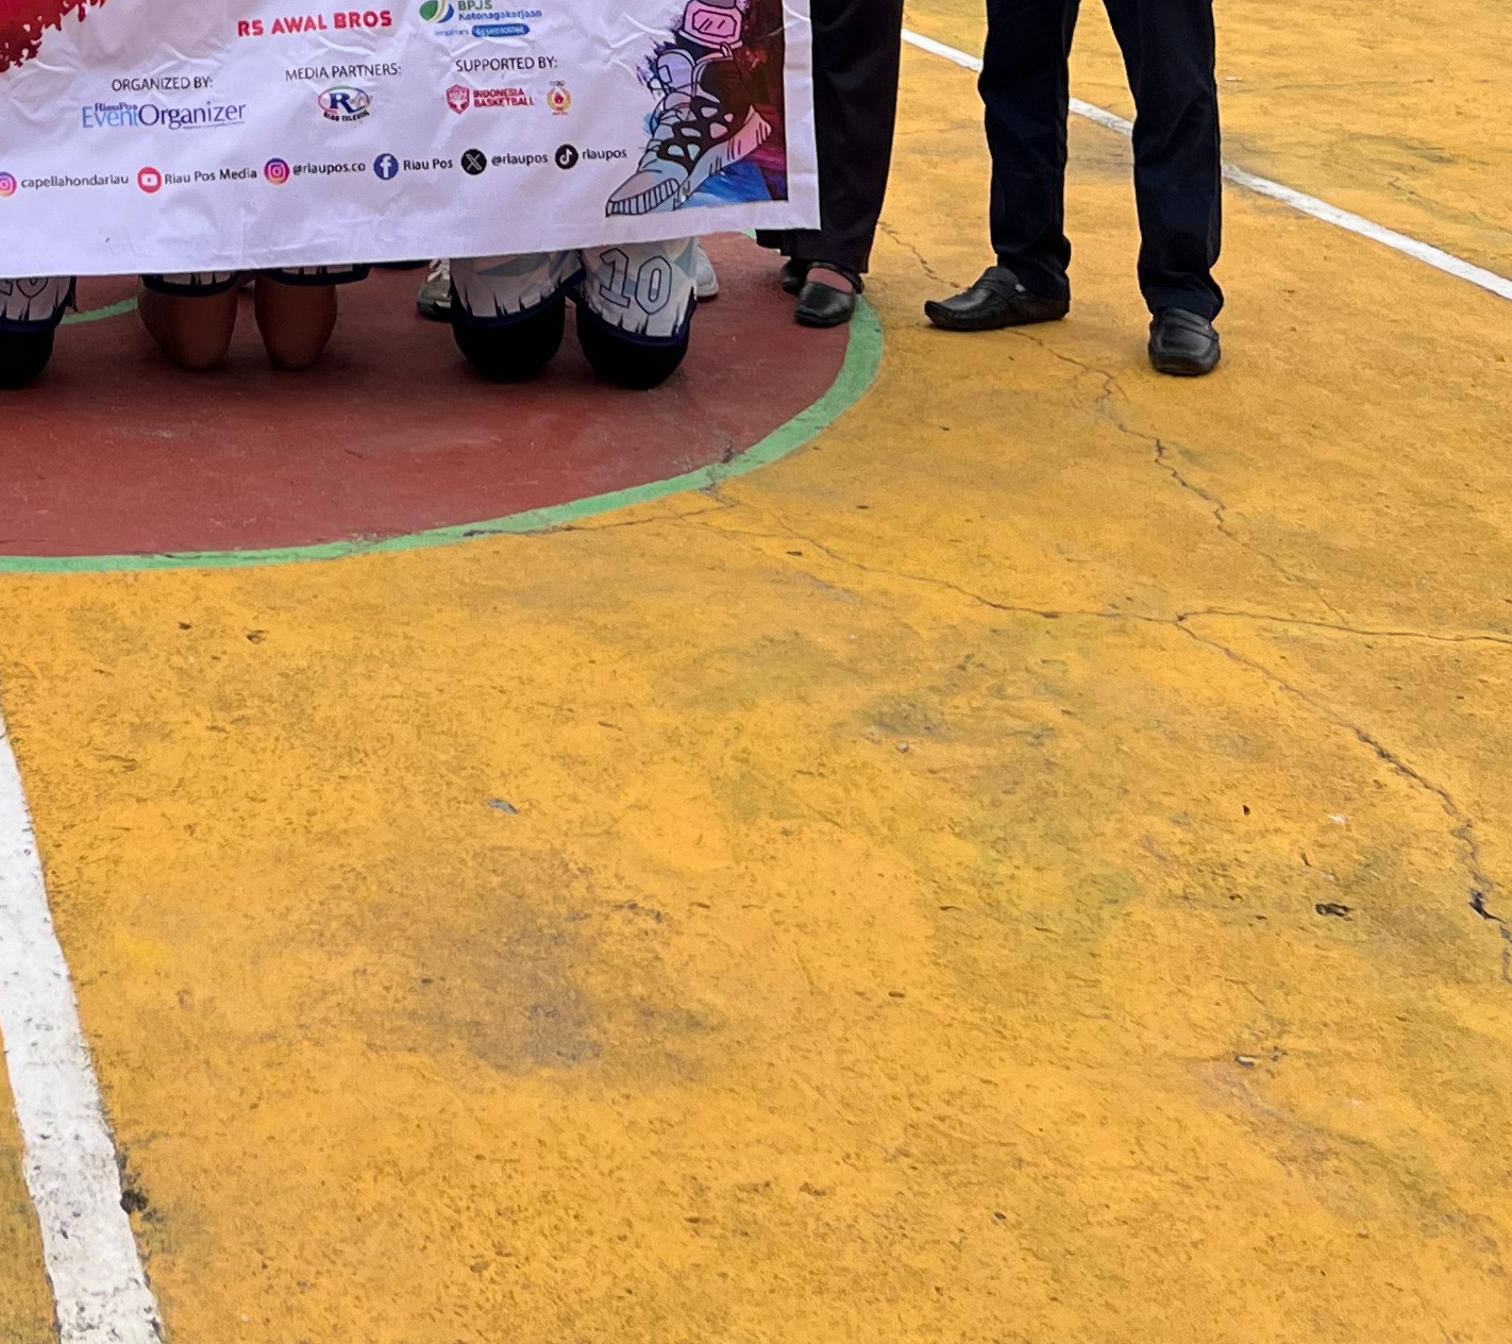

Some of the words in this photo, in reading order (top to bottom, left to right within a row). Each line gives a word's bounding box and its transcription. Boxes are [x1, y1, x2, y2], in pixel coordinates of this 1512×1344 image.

[457, 0, 494, 11] BPJS
[238, 19, 264, 37] RS
[271, 14, 327, 34] AWAL
[334, 10, 393, 29] BROS
[285, 66, 330, 81] MEDIA
[332, 62, 402, 78] PARTNERS:
[455, 56, 536, 72] SUPPORTED
[537, 55, 558, 69] BY:
[111, 76, 192, 92] ORGANIZED
[193, 75, 214, 89] BY:
[474, 96, 535, 108] BASKETBALL
[403, 157, 430, 172] Riau
[432, 156, 454, 170] Pos
[20, 173, 130, 191] capellahondariau
[164, 172, 192, 185] Riau
[193, 170, 217, 183] Pos
[218, 167, 258, 181] Media
[598, 247, 673, 314] 10
